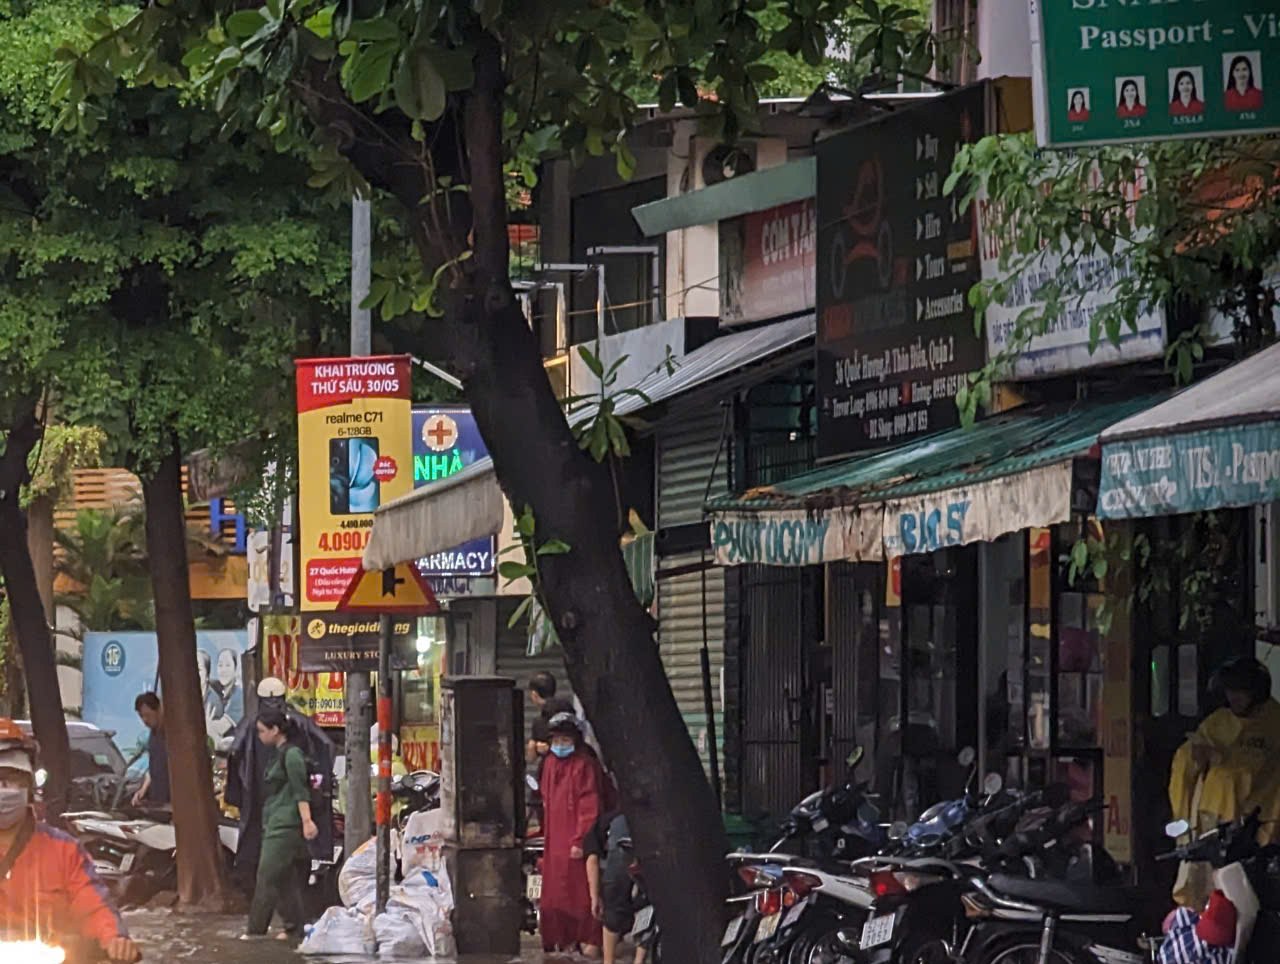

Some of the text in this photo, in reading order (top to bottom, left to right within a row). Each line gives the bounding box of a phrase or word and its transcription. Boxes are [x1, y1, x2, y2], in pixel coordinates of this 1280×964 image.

[1080, 19, 1213, 50] Passport
[1243, 13, 1280, 39] Vi
[315, 362, 395, 378] KHAI TRƯƠNG
[311, 378, 399, 394] THỨ SÁU, 30/05
[325, 411, 383, 425] realme C71
[414, 449, 463, 480] NHÀ
[318, 531, 371, 552] 4.090.
[415, 551, 489, 570] ARMACY
[310, 567, 319, 576] 27
[328, 622, 410, 637] thegioiding
